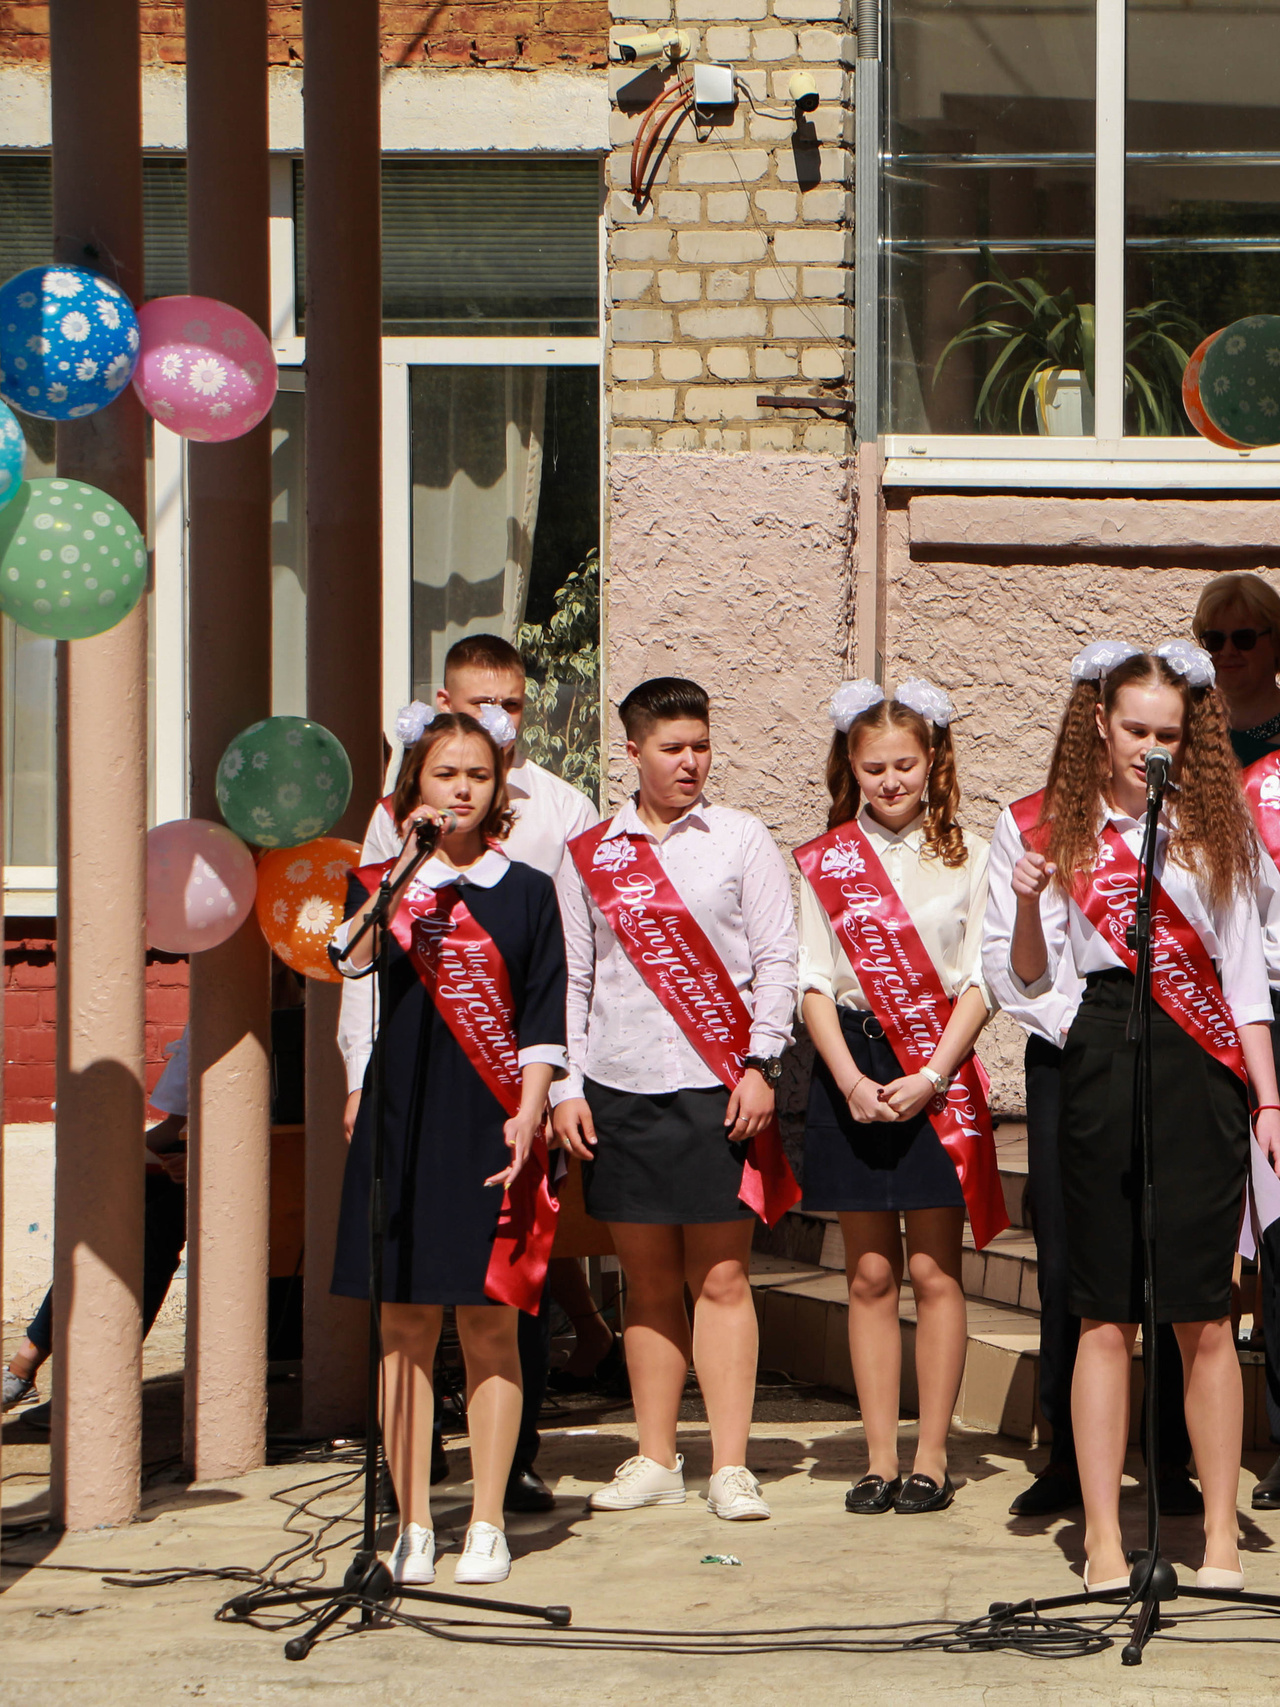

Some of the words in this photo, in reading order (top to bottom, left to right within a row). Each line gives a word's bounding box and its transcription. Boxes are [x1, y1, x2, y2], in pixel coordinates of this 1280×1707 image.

[612, 873, 735, 1043] Выпускник
[657, 908, 700, 966] Мысина
[699, 966, 737, 1024] Валерия
[841, 883, 936, 1057] Выпускник
[882, 918, 919, 985] Устинова
[917, 991, 943, 1036] Ирина
[1093, 872, 1240, 1047] Выускник
[1151, 910, 1197, 975] Ступина
